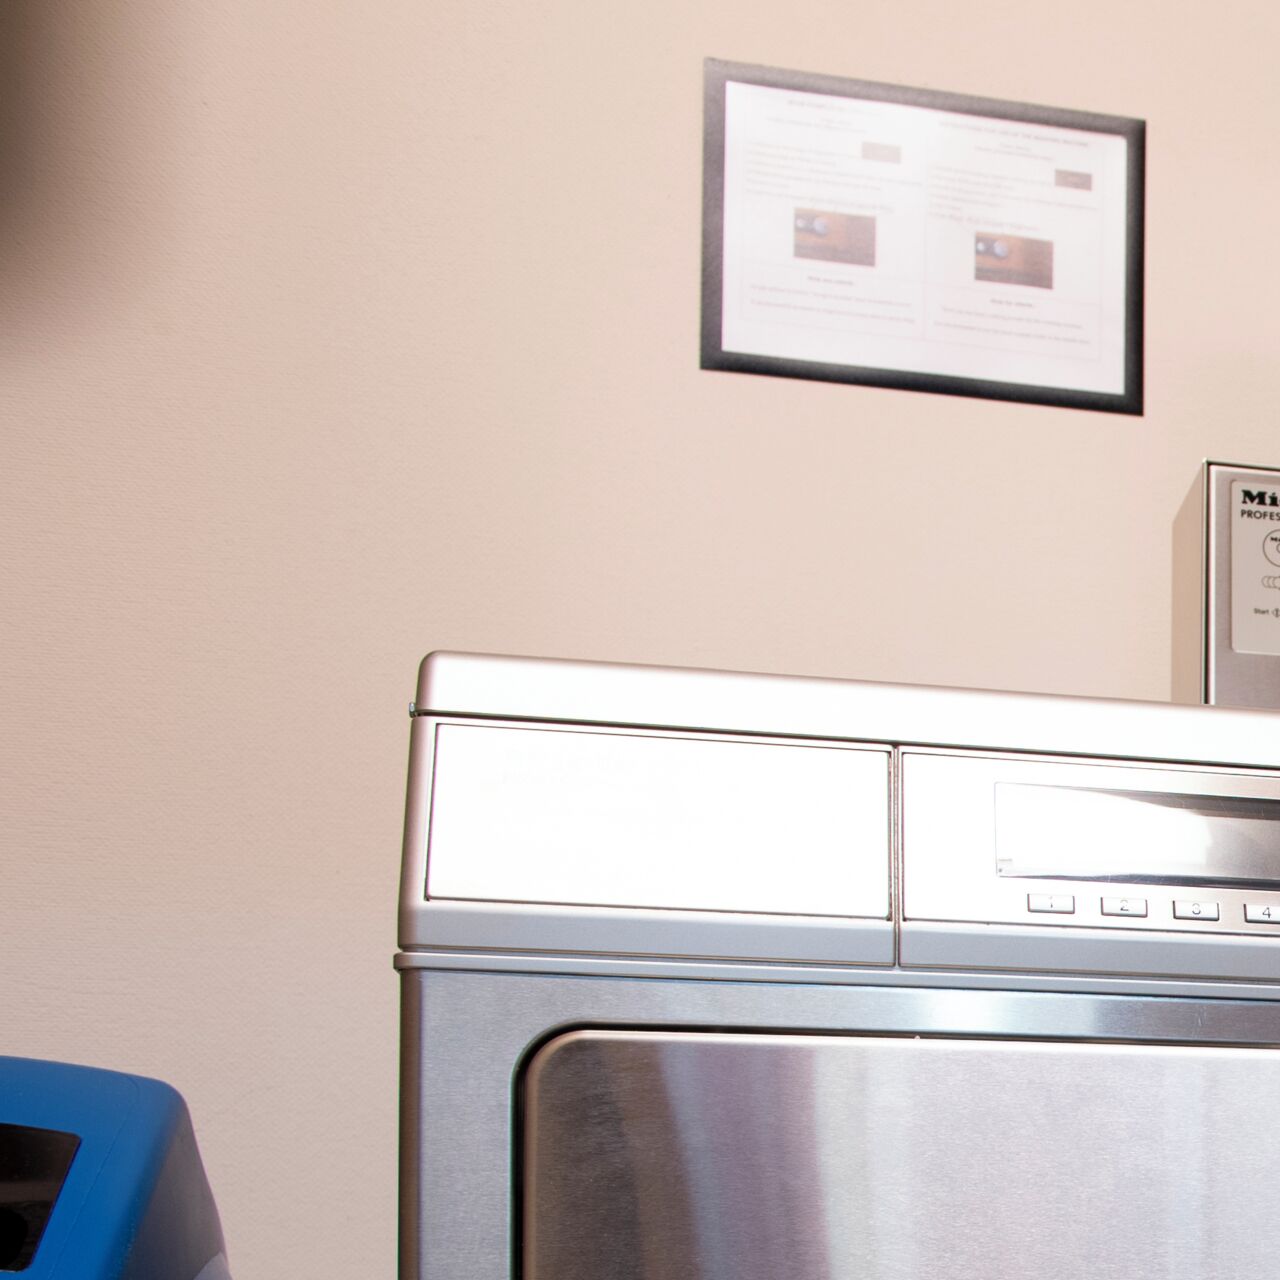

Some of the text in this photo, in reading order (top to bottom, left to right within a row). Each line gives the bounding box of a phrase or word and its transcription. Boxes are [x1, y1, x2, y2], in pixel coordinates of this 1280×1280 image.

[1119, 899, 1129, 912] 2
[1191, 902, 1202, 915] 3
[1262, 906, 1272, 919] 4
